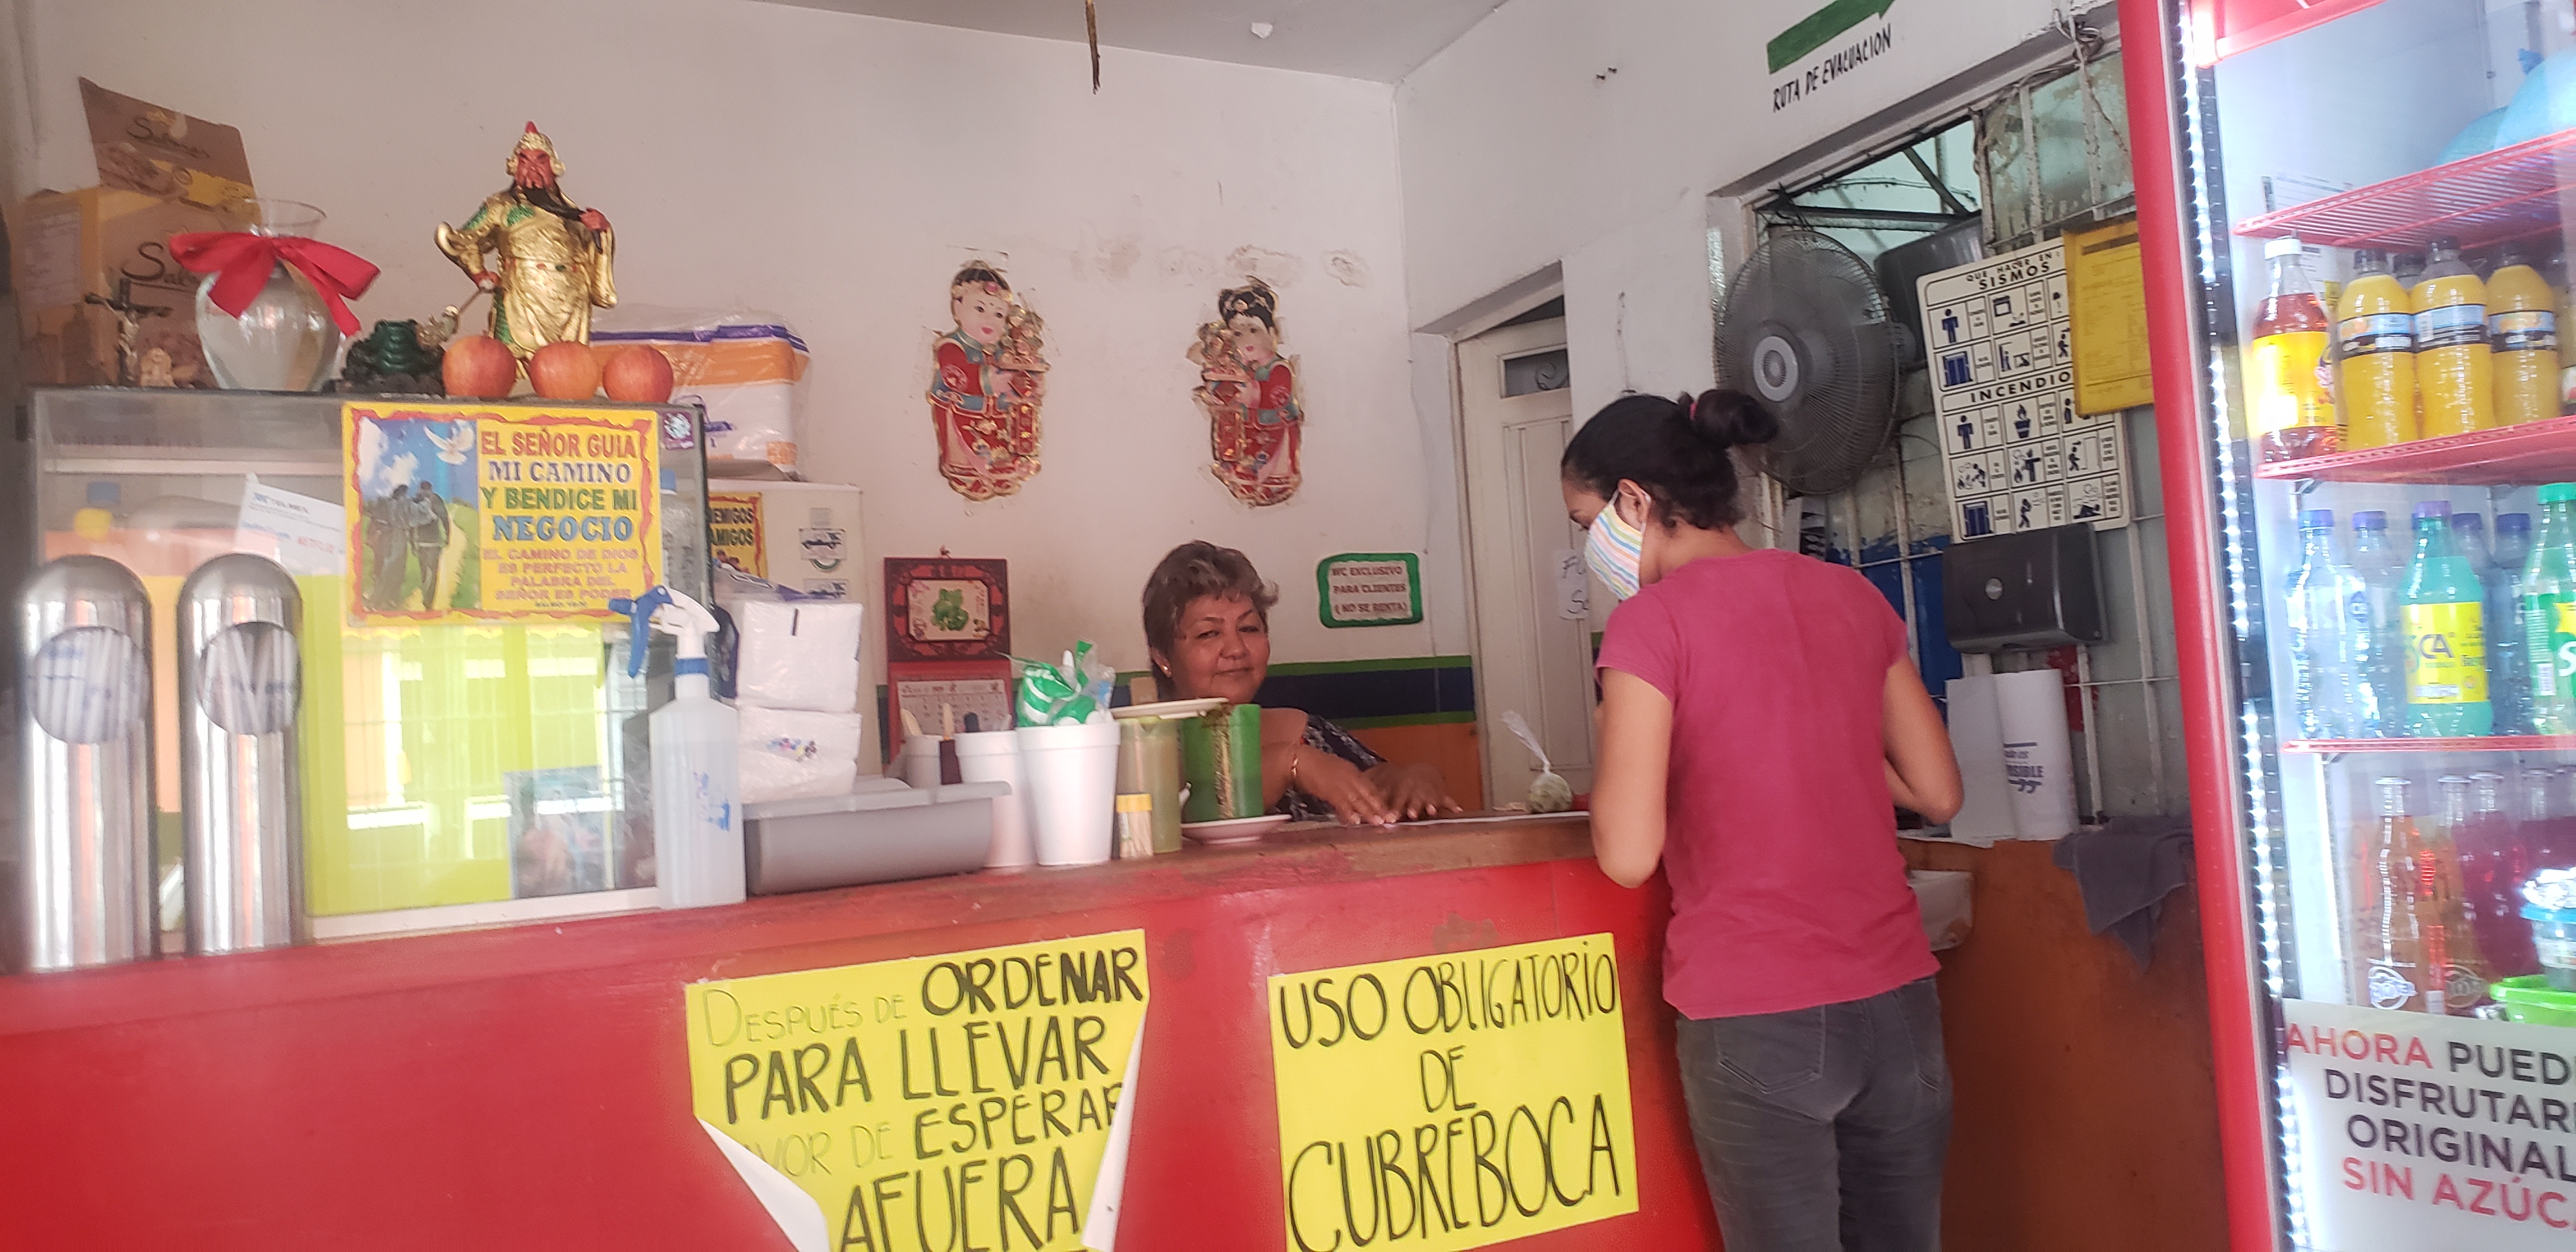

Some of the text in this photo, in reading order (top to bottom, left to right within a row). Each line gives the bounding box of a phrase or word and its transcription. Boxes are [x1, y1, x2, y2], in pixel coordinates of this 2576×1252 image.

[1773, 22, 1891, 113] RUTA DE EVACUACION
[1966, 270, 1988, 282] QUE
[1997, 259, 2030, 273] HACER
[1979, 261, 2050, 290] SISMOS
[1971, 371, 2071, 403] INCENDIO
[481, 426, 637, 459] EL SEÑOR GUIA
[487, 461, 632, 484] MI CAMINO
[479, 486, 637, 510] Y BENDICE MI
[493, 515, 633, 542] NEGOCIO
[482, 548, 639, 560] EL CAMINO DE DIOS
[498, 562, 628, 574] ES PERFECTO LA
[511, 576, 616, 586] PALABRA DEL
[1350, 566, 1403, 576] EXCLUSIVO
[495, 586, 550, 600] SEÑOR
[1333, 584, 1406, 594] PARA CLIENTES
[1358, 603, 1371, 613] SE
[874, 993, 908, 1025] DE
[921, 946, 1144, 1017] ORDENAR
[1279, 940, 1616, 1050] USO OBLIGATORIO
[724, 1015, 1110, 1124] PARA LLEVAR
[2285, 1023, 2576, 1085] AHORA PUED
[1420, 1044, 1477, 1113] DE
[2324, 1068, 2576, 1134] DISFRUTAR
[850, 1121, 893, 1168] DE
[2347, 1113, 2576, 1183] ORIGINAL
[1287, 1092, 1621, 1252] CUBREBOCA
[839, 1147, 1080, 1252] AFUERA
[2342, 1156, 2576, 1232] SIN AZÚC
